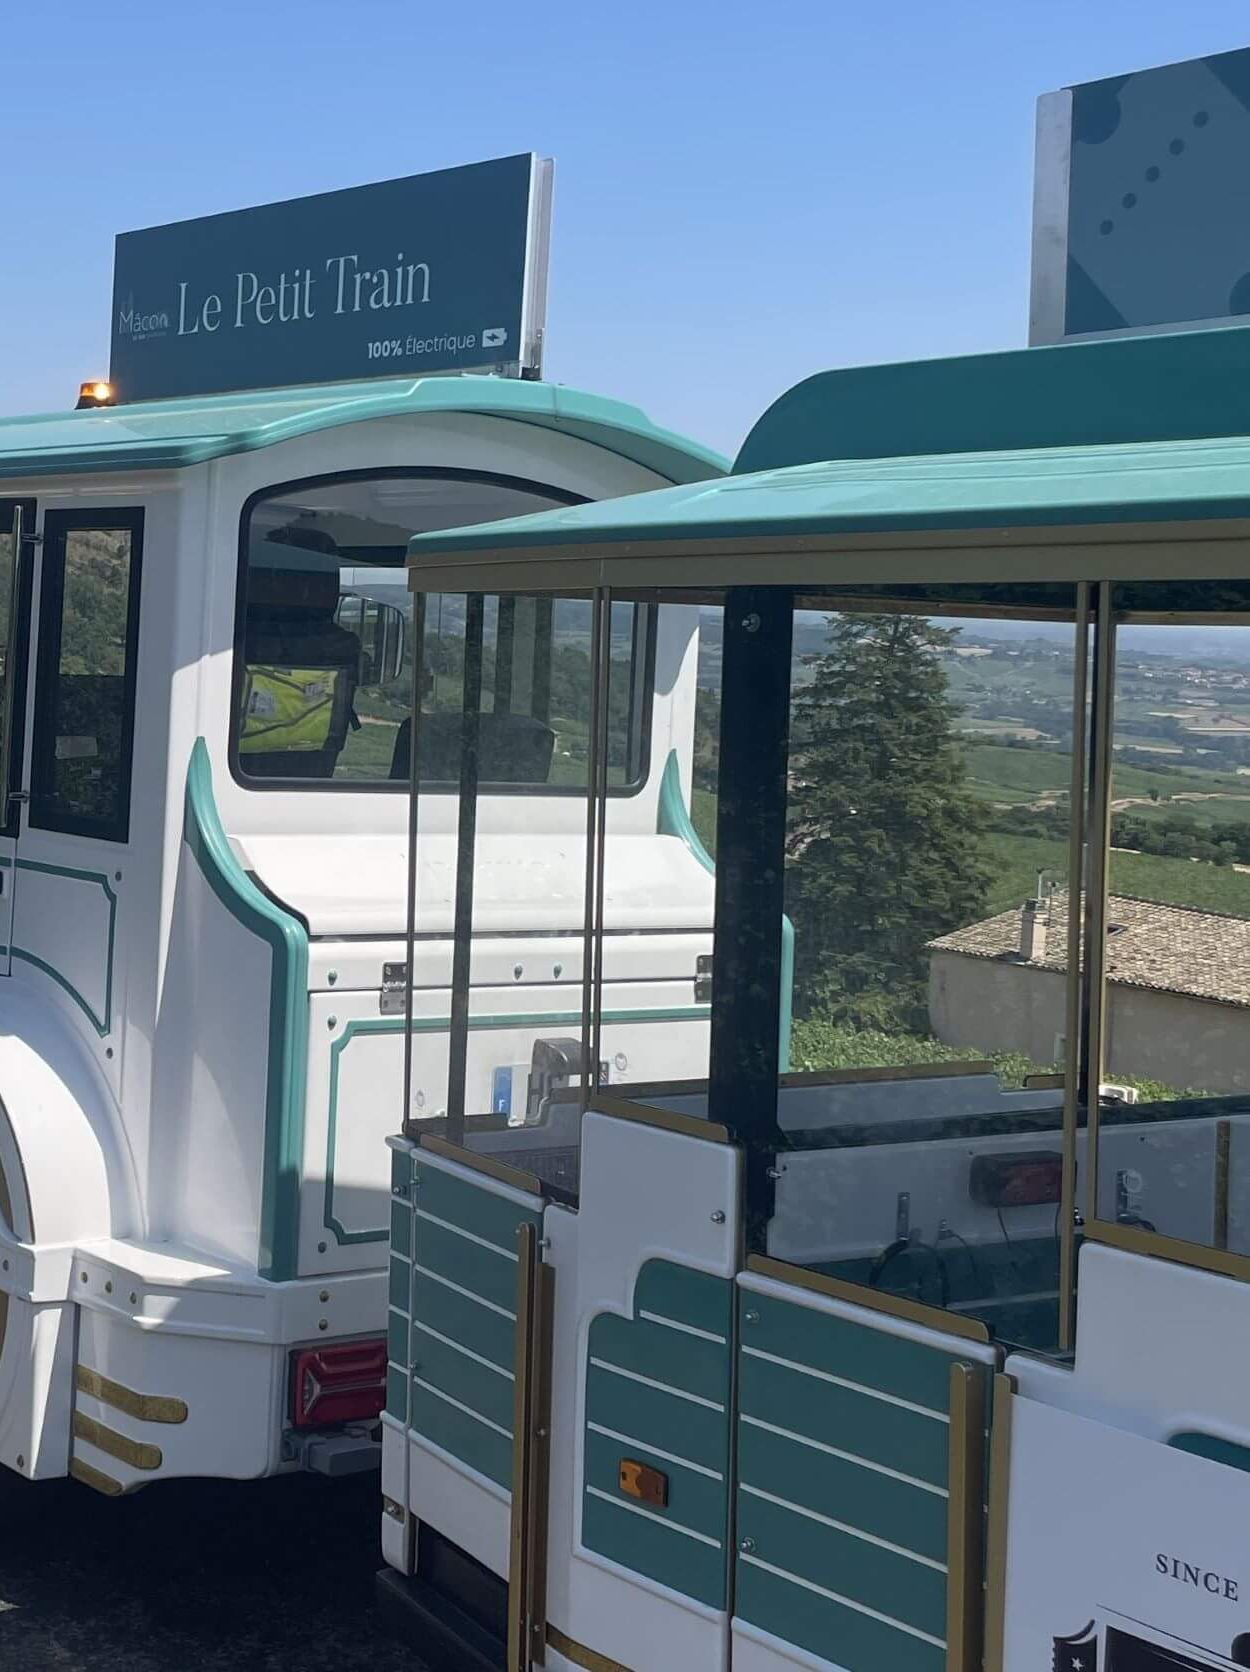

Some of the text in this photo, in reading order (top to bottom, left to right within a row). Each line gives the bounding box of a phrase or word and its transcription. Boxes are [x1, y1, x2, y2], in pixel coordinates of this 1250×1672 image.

[177, 252, 431, 335] Le Petit Train
[367, 333, 476, 359] 100% Électrique
[1155, 1552, 1239, 1602] SINCE
